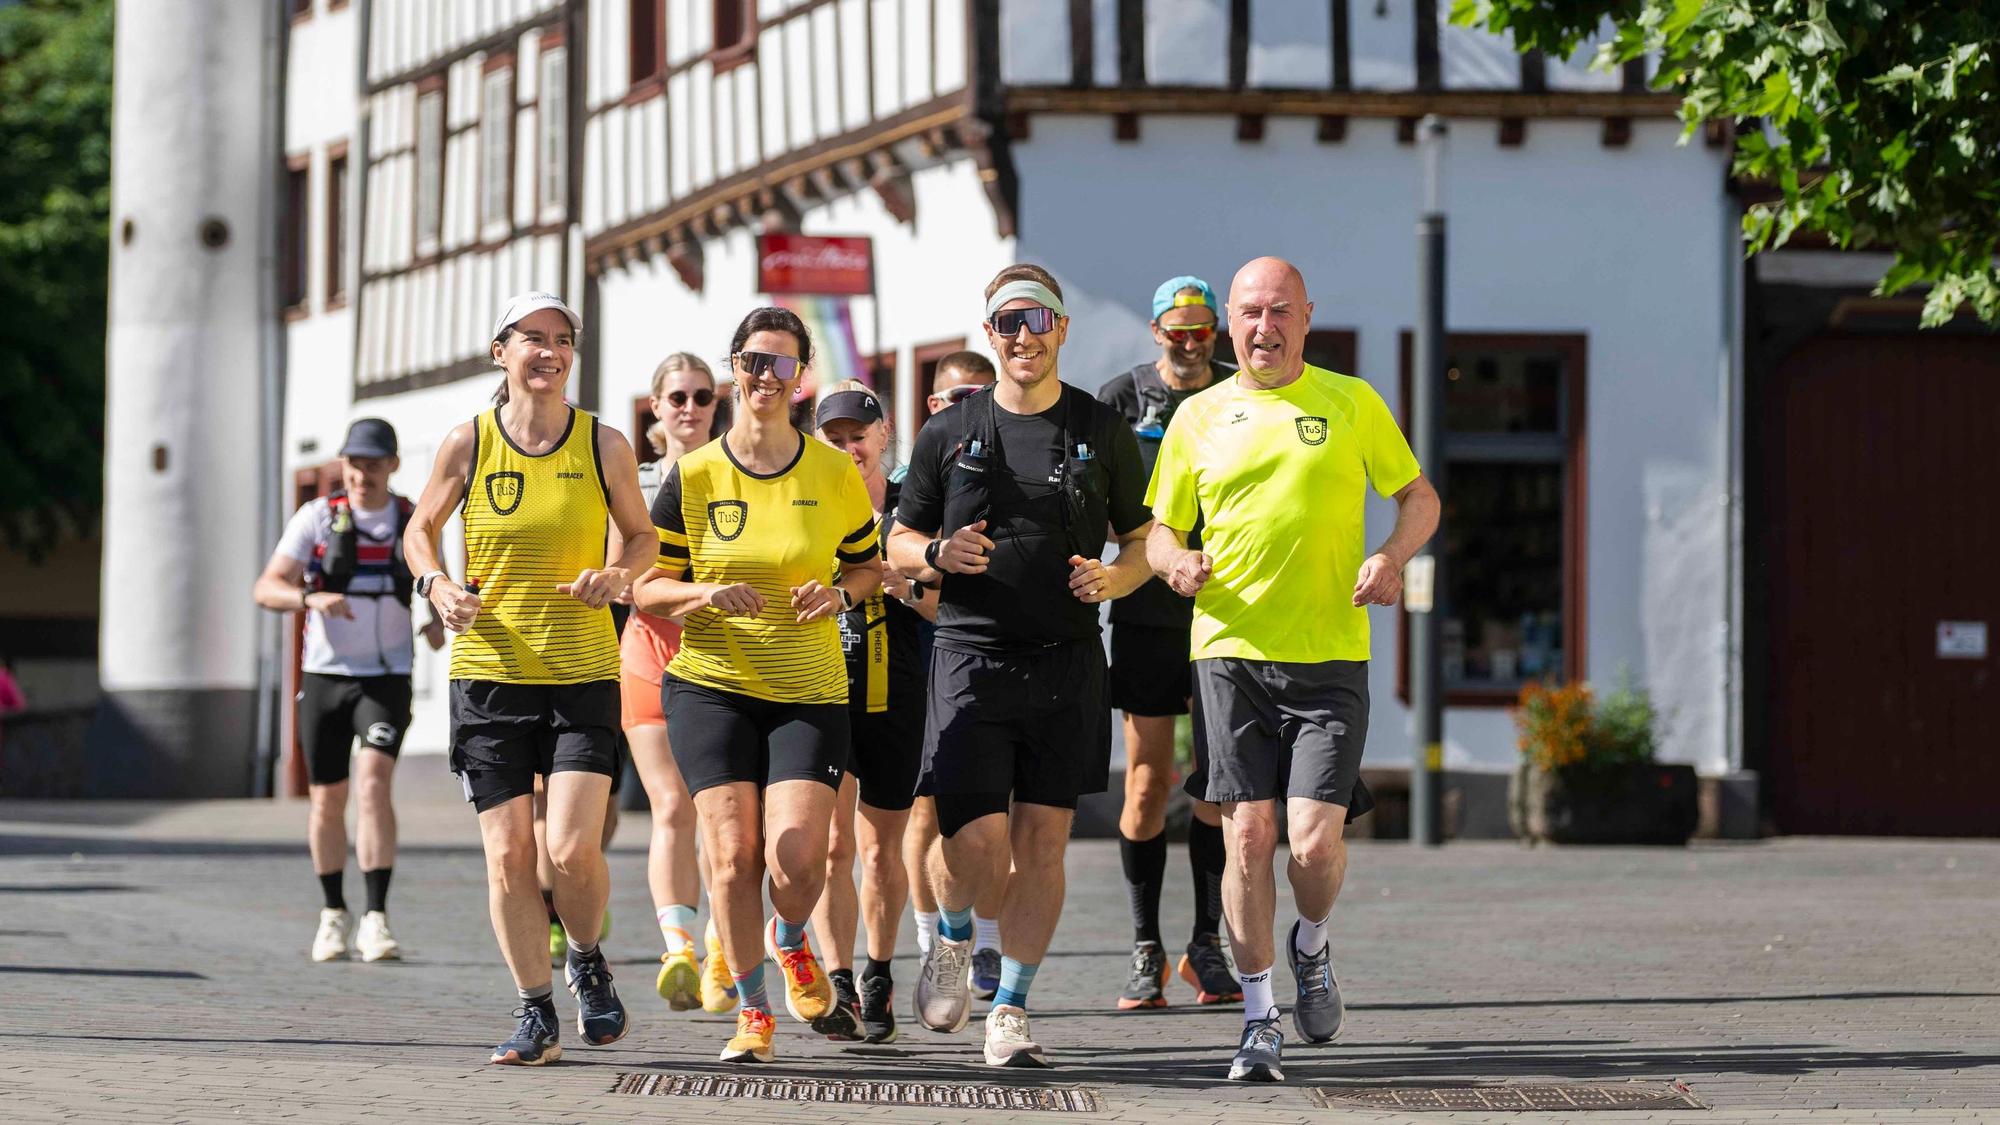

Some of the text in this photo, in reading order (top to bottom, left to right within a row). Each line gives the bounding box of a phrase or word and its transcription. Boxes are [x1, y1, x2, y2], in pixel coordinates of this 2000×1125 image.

[1303, 425, 1321, 434] TuS
[957, 462, 983, 472] SALOMON
[495, 482, 516, 496] TuS
[718, 510, 739, 523] TuS
[874, 630, 882, 664] RHEDER
[1241, 973, 1268, 983] cep
